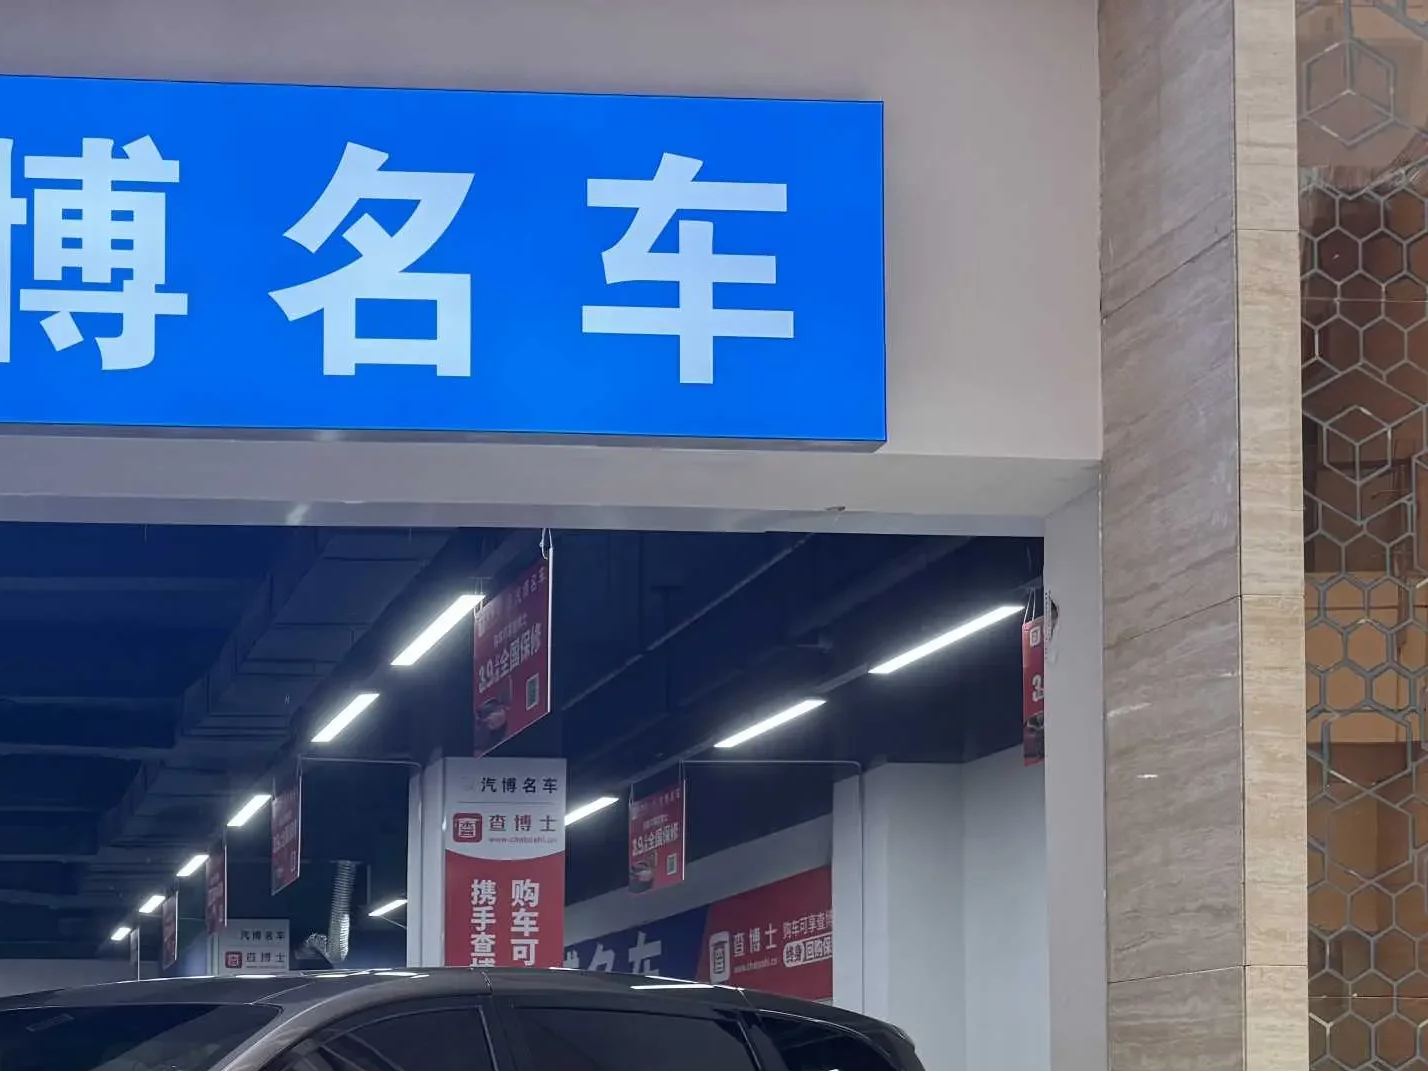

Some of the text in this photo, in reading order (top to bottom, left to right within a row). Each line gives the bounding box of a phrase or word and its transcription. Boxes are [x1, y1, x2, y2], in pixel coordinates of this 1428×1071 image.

[480, 777, 558, 794] 汽博名车
[488, 814, 558, 832] 查博士
[510, 878, 541, 967] 购车可
[733, 923, 778, 957] 查博士
